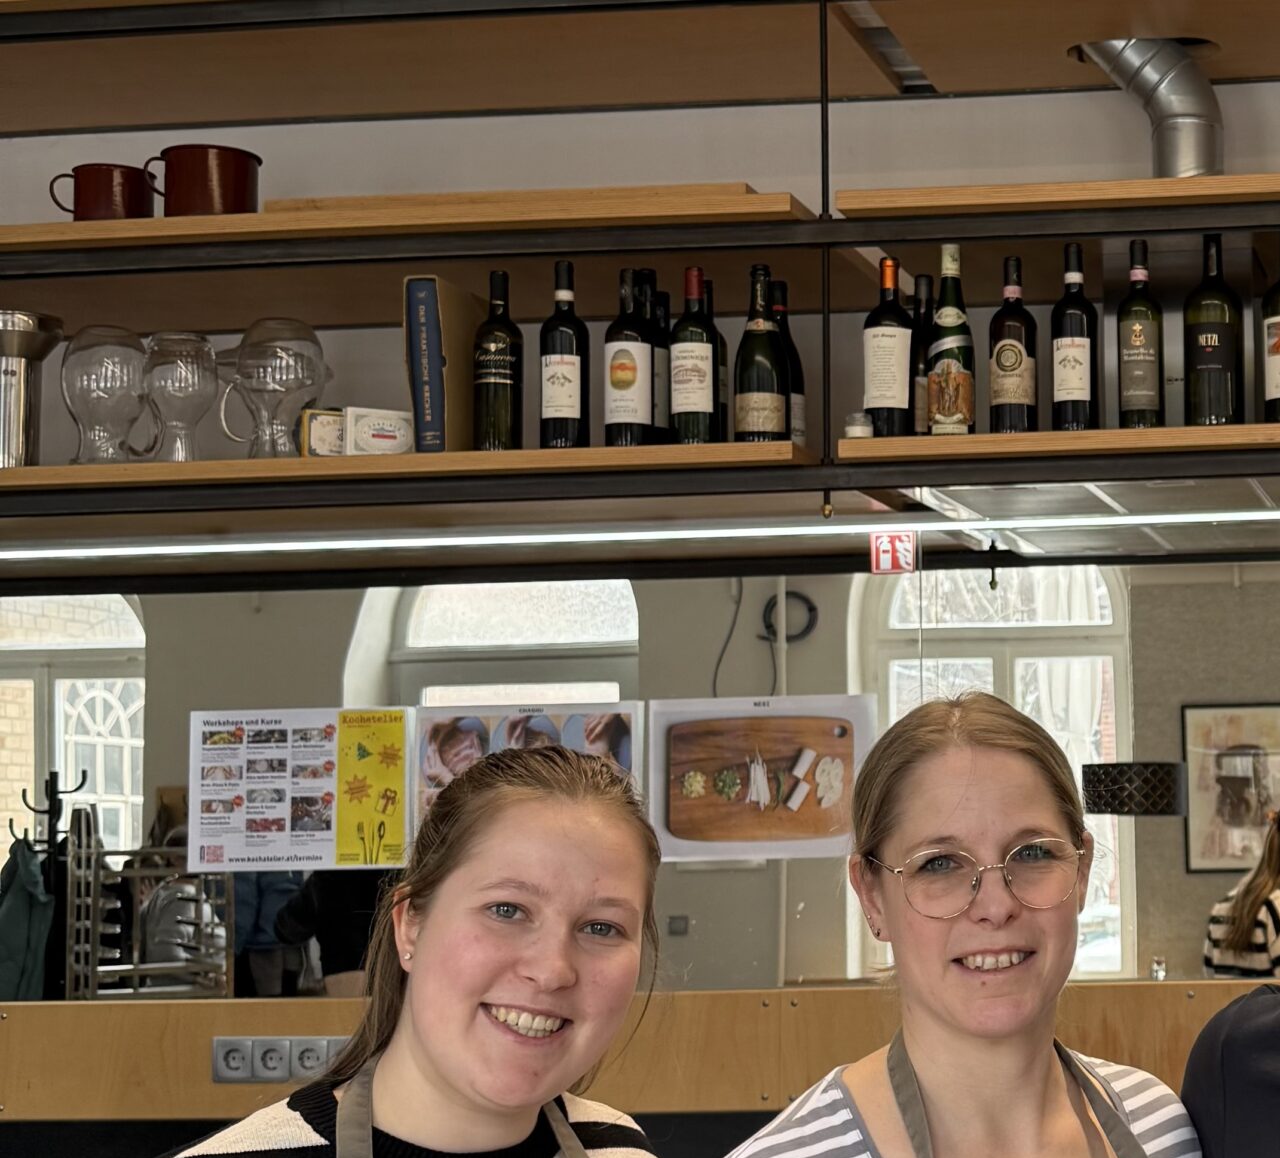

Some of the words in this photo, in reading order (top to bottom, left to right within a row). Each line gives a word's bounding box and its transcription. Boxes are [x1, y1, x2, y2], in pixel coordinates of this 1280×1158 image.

[1198, 333, 1220, 346] NETZL
[202, 718, 244, 727] Workshops
[245, 718, 259, 726] und
[260, 717, 283, 726] Kurse
